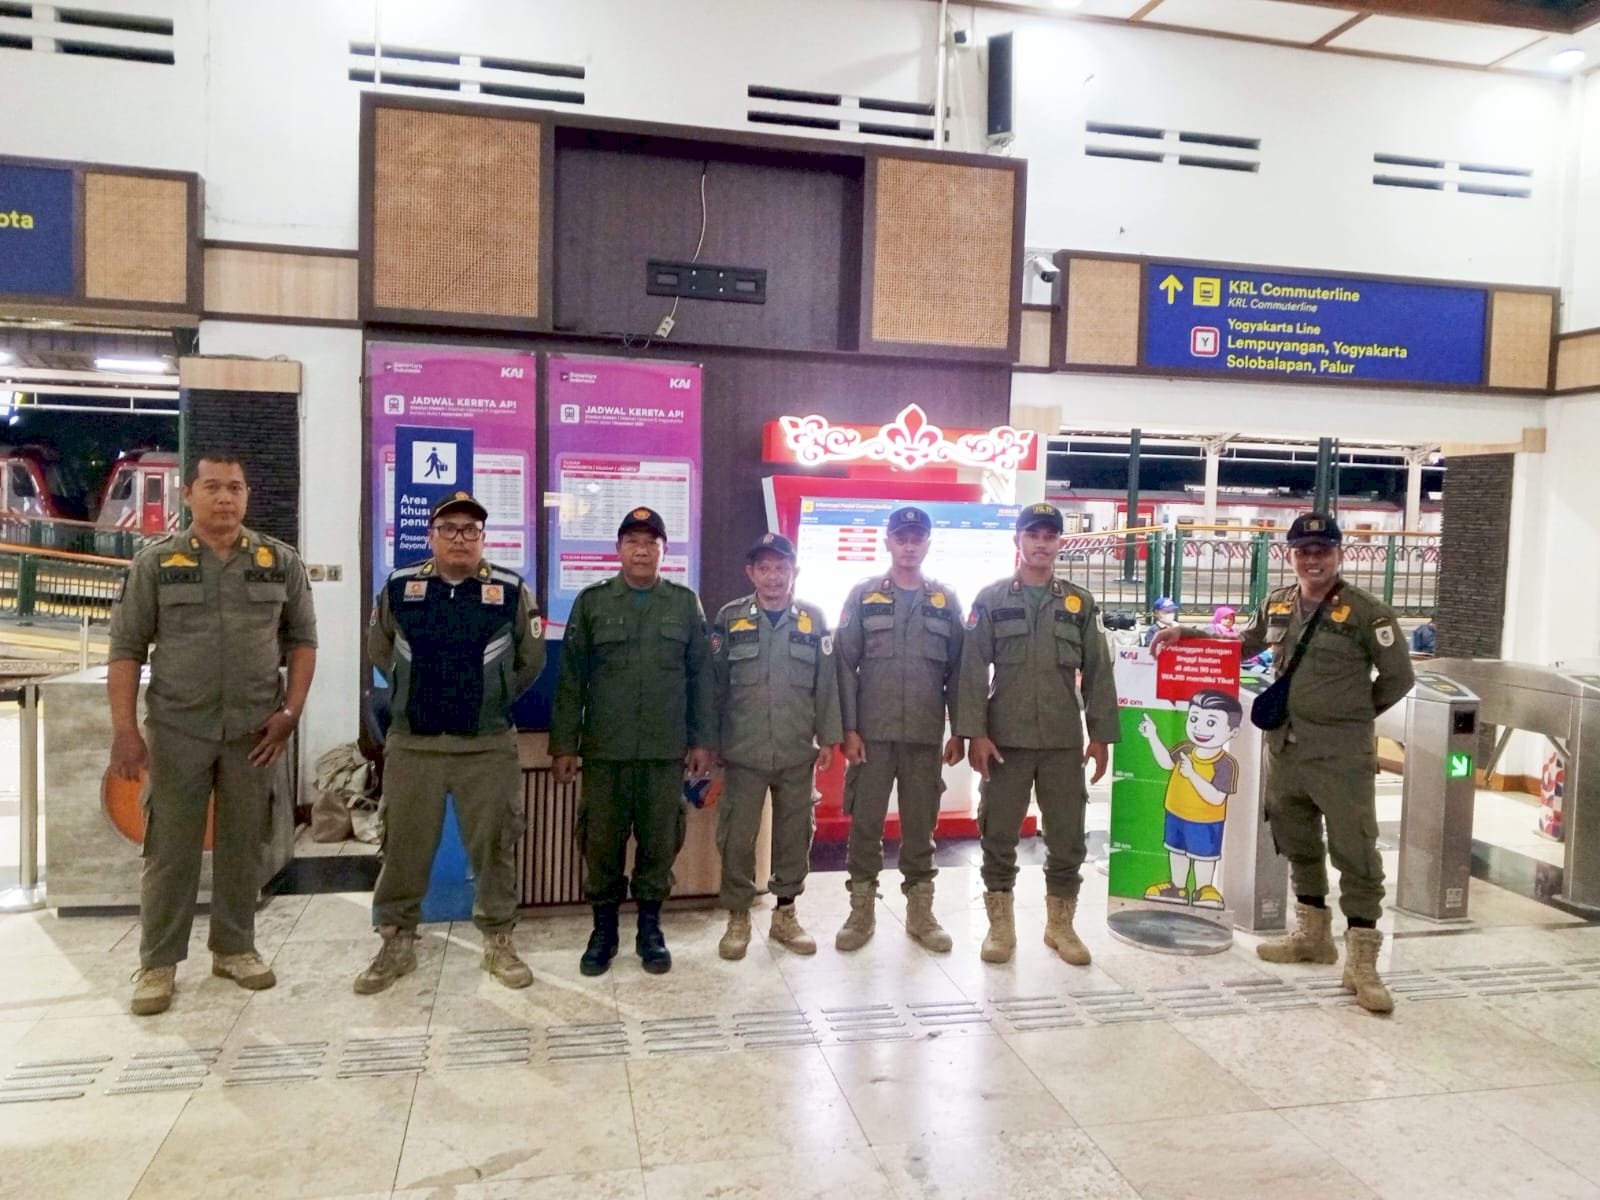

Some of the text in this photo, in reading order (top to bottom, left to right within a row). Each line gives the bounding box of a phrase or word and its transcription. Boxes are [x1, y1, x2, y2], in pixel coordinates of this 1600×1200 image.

[1229, 280, 1360, 302] KRL Commuterline
[1228, 297, 1318, 313] KRL Commuterline
[1228, 318, 1321, 335] Yogyakarta Line
[1201, 336, 1210, 348] Y
[1227, 335, 1408, 358] Lempuyangan, Yogyakarta
[1227, 354, 1355, 374] Solobalapan, Palur
[501, 367, 524, 379] KAI
[669, 378, 691, 389] KAI
[410, 396, 517, 409] JADWAL KERETA API
[585, 406, 684, 418] JADWAL KERETA API
[400, 494, 428, 505] Area
[400, 541, 427, 550] beyond
[1120, 651, 1138, 660] KAI
[1204, 646, 1232, 656] dengan
[1176, 655, 1221, 665] tinggi badan
[1161, 673, 1186, 682] WAJIB
